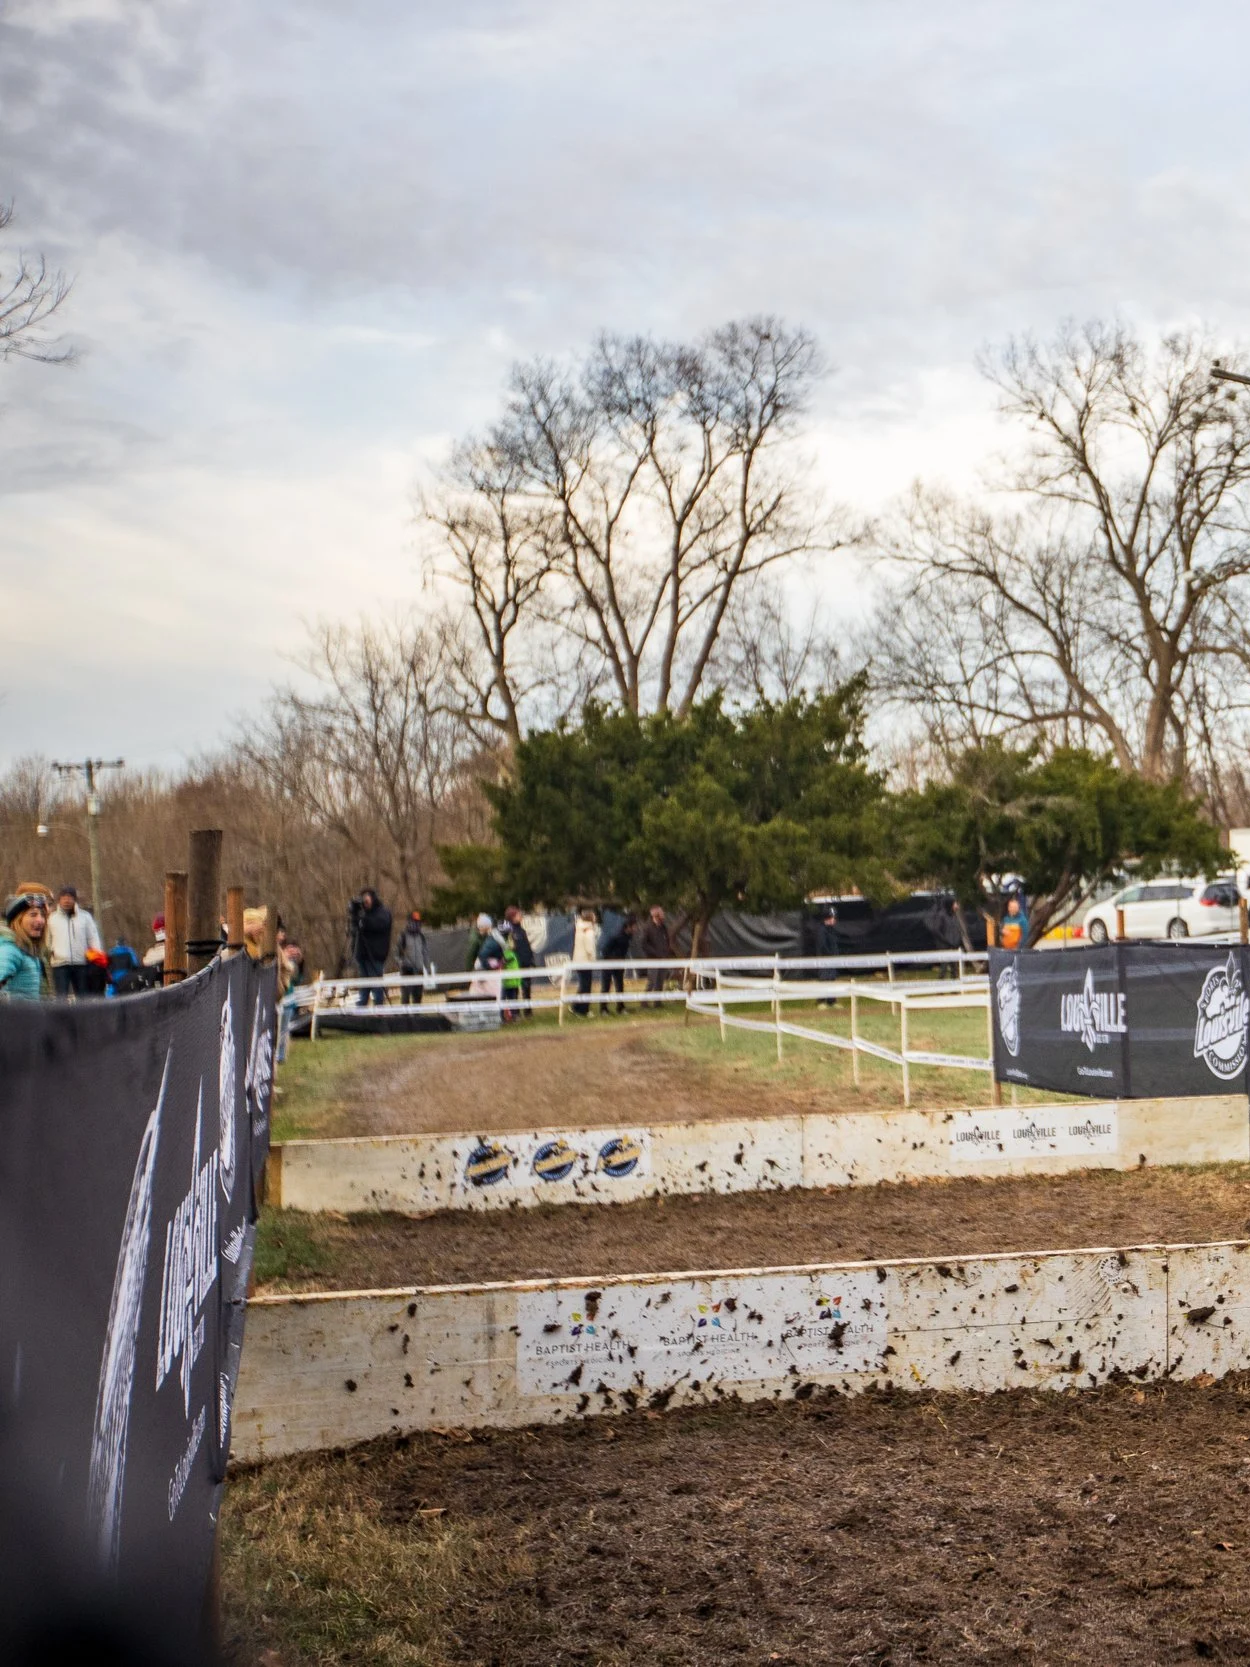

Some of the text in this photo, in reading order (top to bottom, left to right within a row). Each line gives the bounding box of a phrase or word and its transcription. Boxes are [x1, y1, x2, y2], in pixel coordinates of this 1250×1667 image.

[711, 1332, 755, 1344] HEALTH
[536, 1340, 631, 1356] BAPTIST HEALTH
